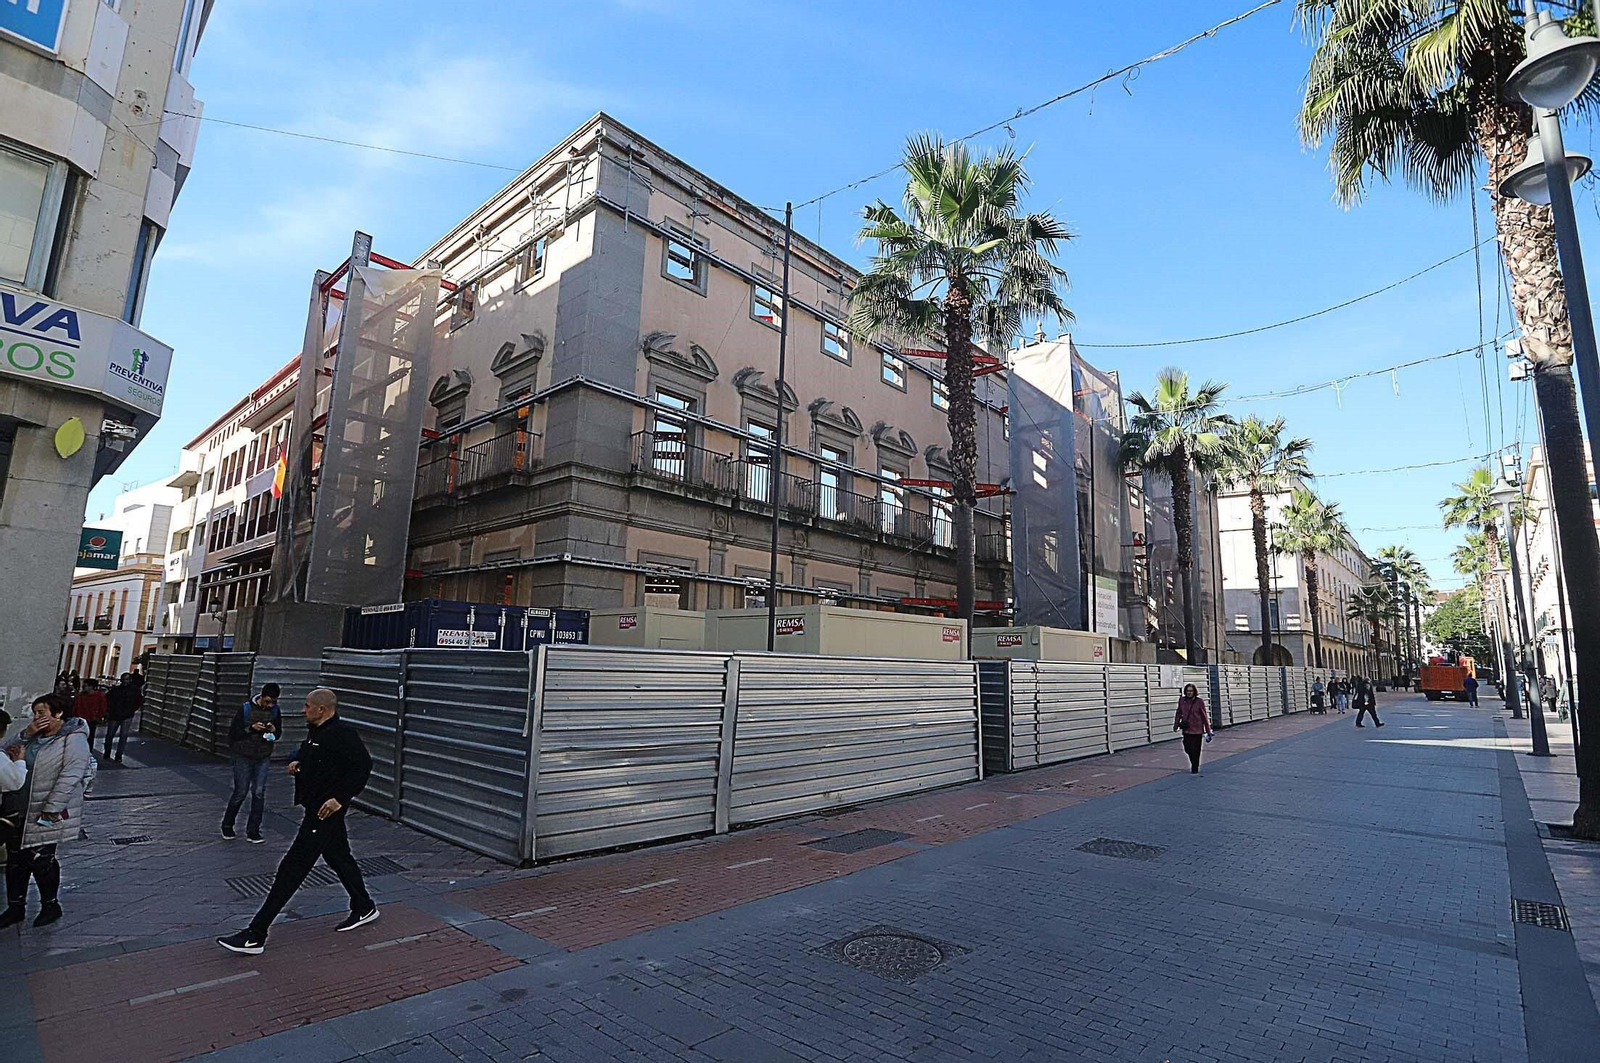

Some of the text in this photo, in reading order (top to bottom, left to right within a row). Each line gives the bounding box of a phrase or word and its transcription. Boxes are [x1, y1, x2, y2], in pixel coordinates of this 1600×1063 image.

[0, 339, 76, 379] OS
[109, 362, 163, 393] PREVENTIVA
[127, 386, 161, 407] SEGUROS
[620, 616, 637, 624] REMSA
[777, 618, 805, 628] REMSA
[943, 628, 960, 637] REMSA
